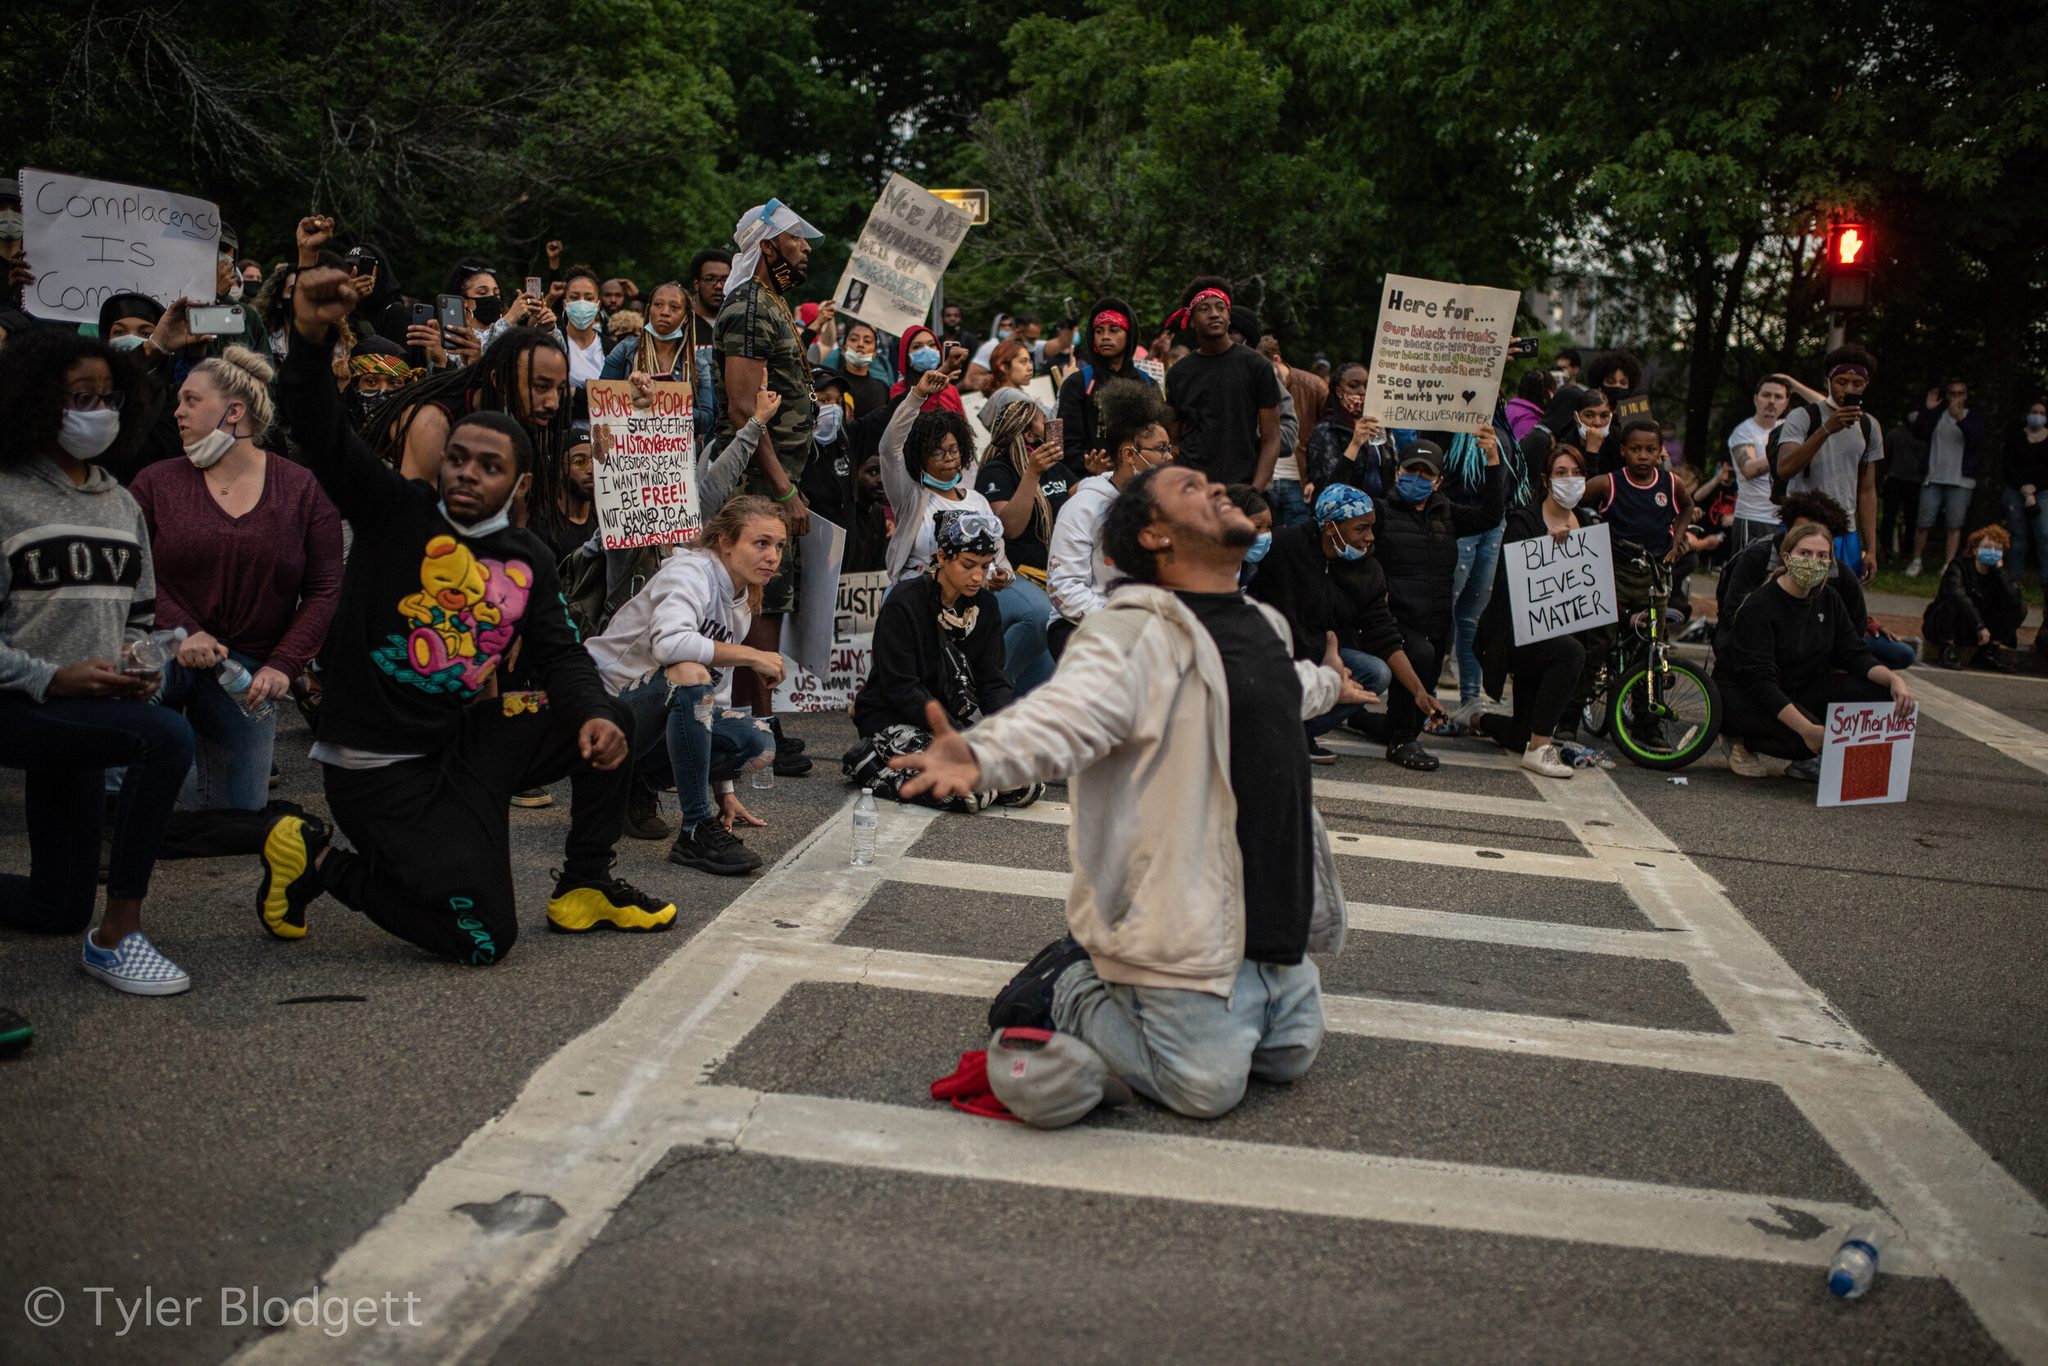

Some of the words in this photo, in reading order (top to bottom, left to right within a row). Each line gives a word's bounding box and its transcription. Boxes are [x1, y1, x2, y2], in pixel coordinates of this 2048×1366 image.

[36, 181, 219, 240] Complacency
[81, 234, 155, 267] IS
[1388, 289, 1438, 318] Here
[1381, 336, 1401, 348] Our
[1403, 338, 1433, 350] black
[1382, 321, 1409, 336] Our
[1411, 324, 1446, 341] black
[1447, 326, 1497, 344] friends
[1379, 348, 1401, 359] Our
[1401, 349, 1431, 361] black
[1378, 359, 1399, 370] Our
[1399, 361, 1428, 374] black
[1377, 374, 1386, 385] I
[1388, 376, 1412, 388] see
[1416, 379, 1444, 391] you.
[650, 390, 693, 417] PEOPLE
[1384, 389, 1404, 401] I'm
[1407, 391, 1433, 403] with
[1435, 393, 1455, 404] you
[603, 454, 650, 473] ANCESTORS
[599, 476, 610, 494] I
[612, 473, 639, 490] WANT
[640, 471, 650, 487] MY
[650, 471, 668, 486] KIDS
[669, 471, 682, 485] TO
[620, 489, 640, 510] BE
[641, 481, 687, 508] FREE!!
[601, 508, 620, 529] NOT
[619, 507, 659, 527] CHAINED
[661, 506, 676, 520] TO
[678, 505, 688, 519] A
[659, 512, 701, 533] COMMUNITY
[1521, 532, 1599, 570] BLACK
[1528, 564, 1596, 603] LIVES
[1528, 590, 1610, 636] MATTER
[794, 675, 817, 692] US
[1830, 706, 1860, 736] Say
[1860, 709, 1886, 734] Their
[1886, 711, 1916, 734] Names
